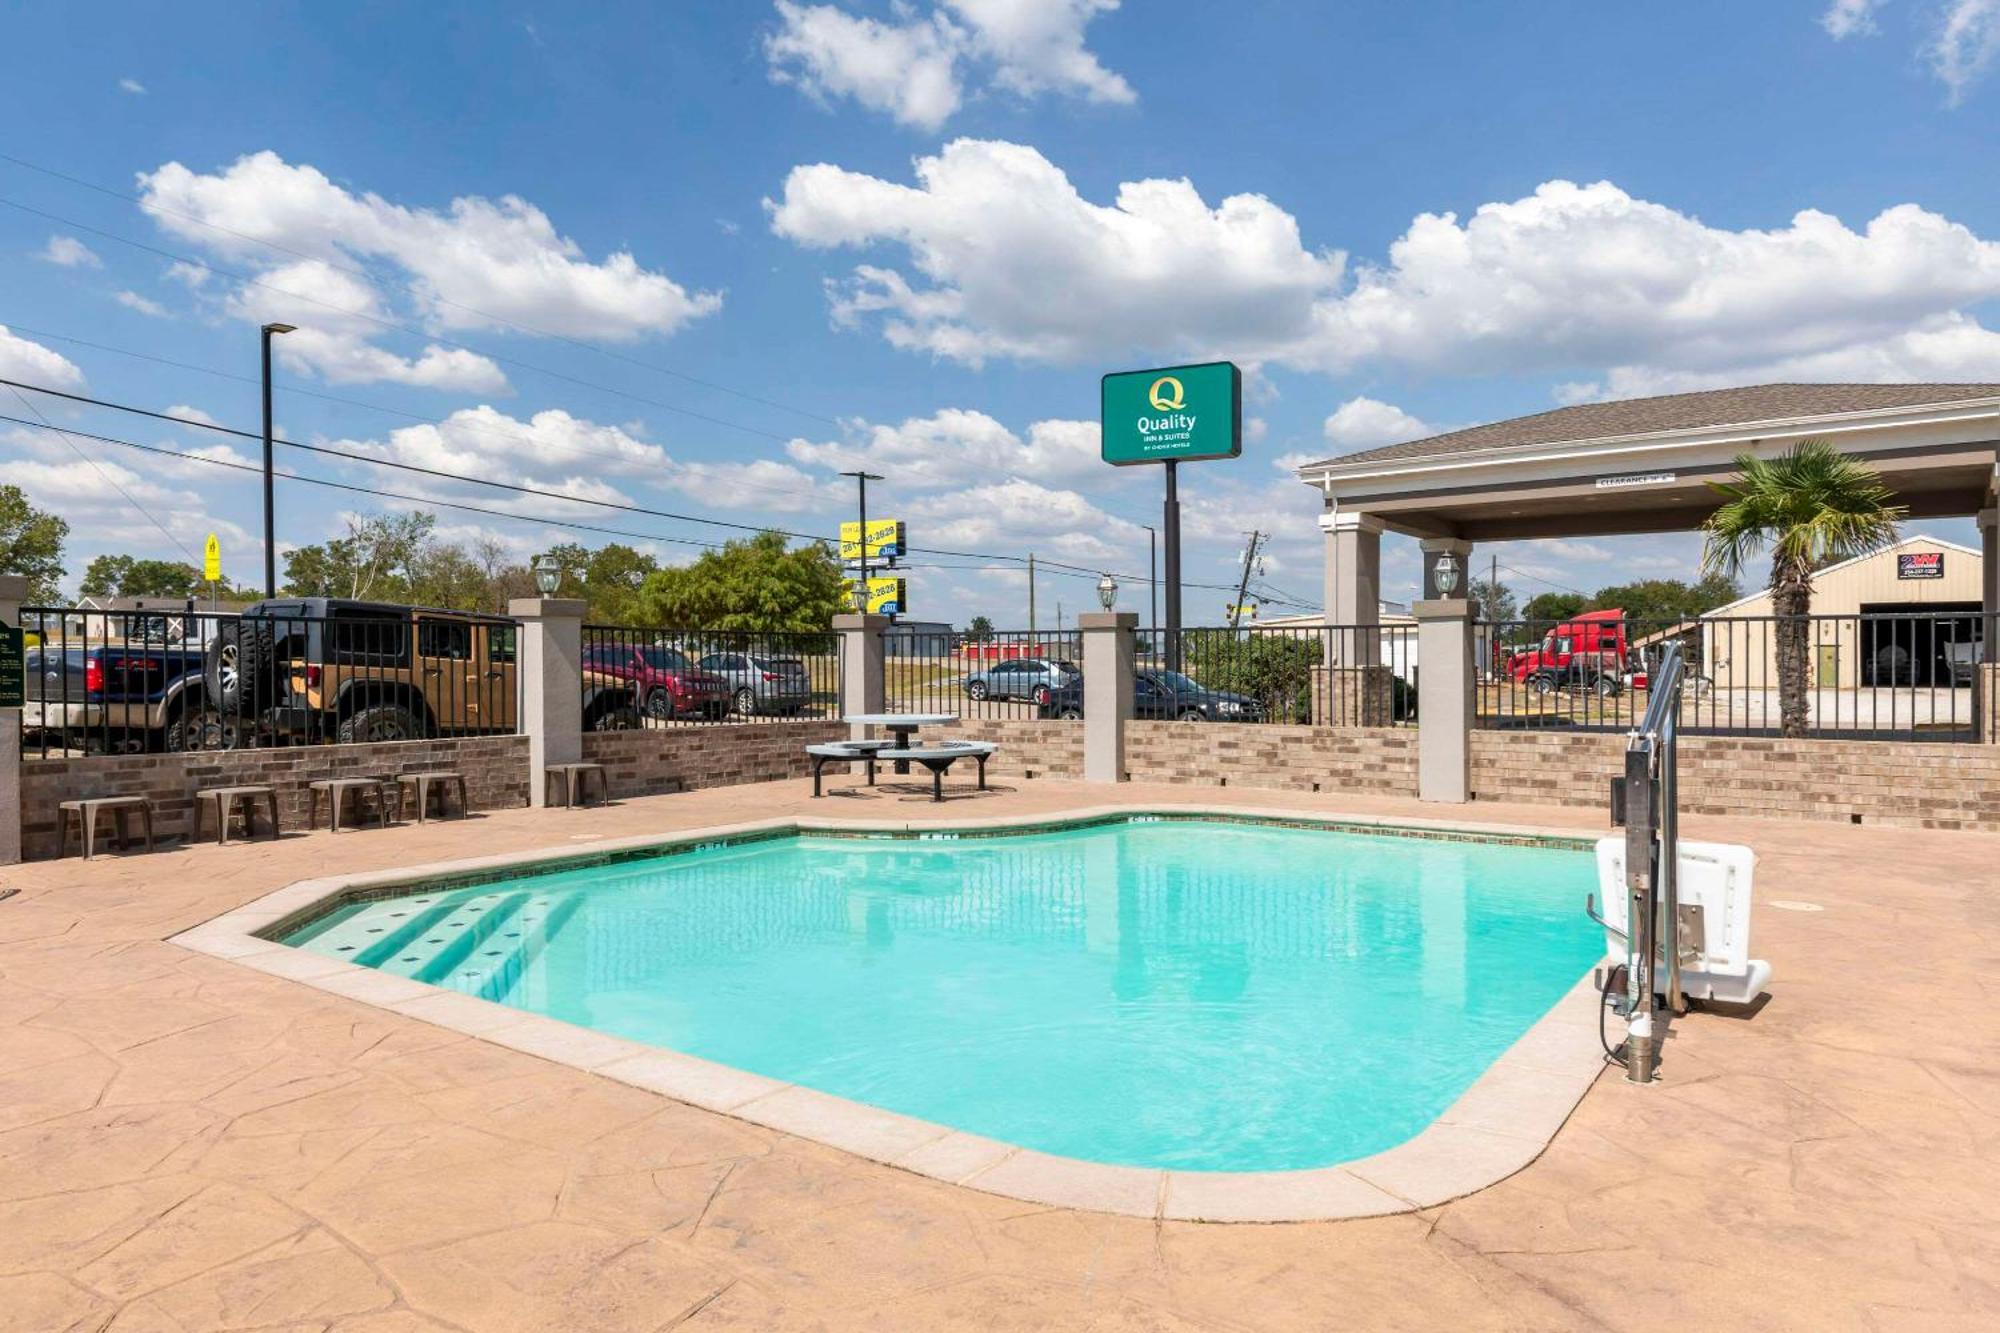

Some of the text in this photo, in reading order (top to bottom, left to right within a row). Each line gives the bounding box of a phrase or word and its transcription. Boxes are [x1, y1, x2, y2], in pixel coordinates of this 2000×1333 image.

[1138, 414, 1196, 434] Quality
[1164, 432, 1190, 440] SUITES
[1600, 475, 1647, 486] CLEARANCE
